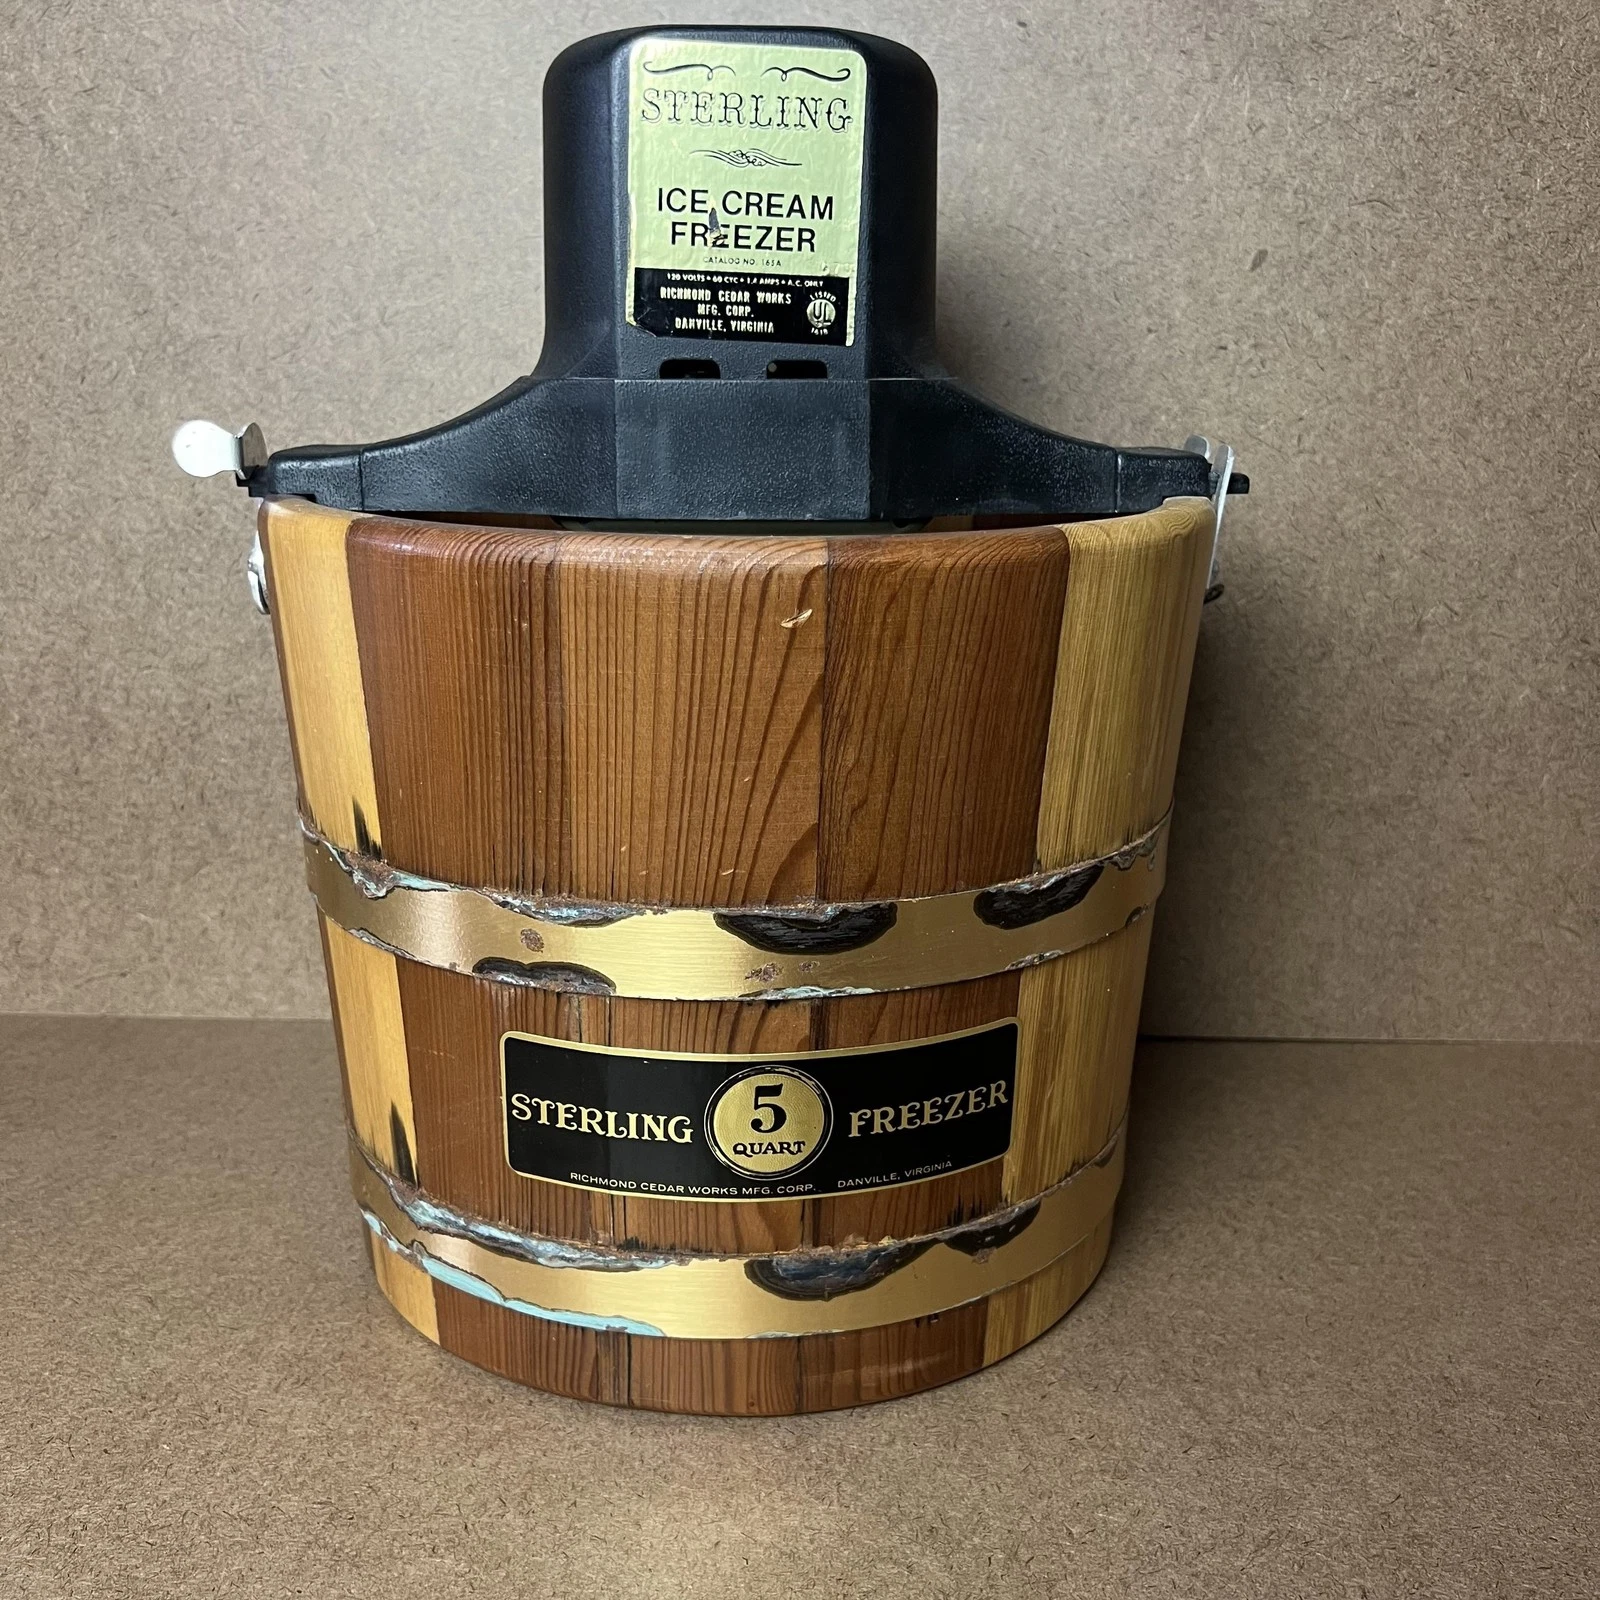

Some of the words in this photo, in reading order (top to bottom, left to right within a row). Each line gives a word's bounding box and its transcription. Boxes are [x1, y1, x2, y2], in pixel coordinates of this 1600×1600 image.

[641, 87, 853, 133] STERLING
[658, 187, 709, 214] ICE
[722, 190, 834, 220] CREAM
[703, 256, 740, 265] CATALOG
[667, 272, 681, 281] 120
[682, 273, 706, 282] VOLTS
[660, 286, 711, 301] RICHMOND
[718, 290, 750, 303] CEDAR
[756, 291, 792, 305] WORKS
[697, 303, 721, 316] MFG.
[725, 305, 754, 318] CORP.
[675, 317, 727, 332] DANVILLE,
[730, 320, 775, 333] VIRGINIA
[511, 1093, 694, 1144] STERLING
[750, 1082, 787, 1134] 5
[848, 1079, 1008, 1138] FREEZER
[733, 1140, 806, 1157] QUART
[570, 1171, 637, 1190] RICHMOND
[640, 1182, 685, 1194] CEDAR
[688, 1185, 738, 1196] WORKS
[741, 1186, 774, 1195] MFG.
[777, 1183, 817, 1194] CORP.
[837, 1172, 901, 1189] DANVILLE,
[904, 1160, 953, 1178] VIRGINIA
